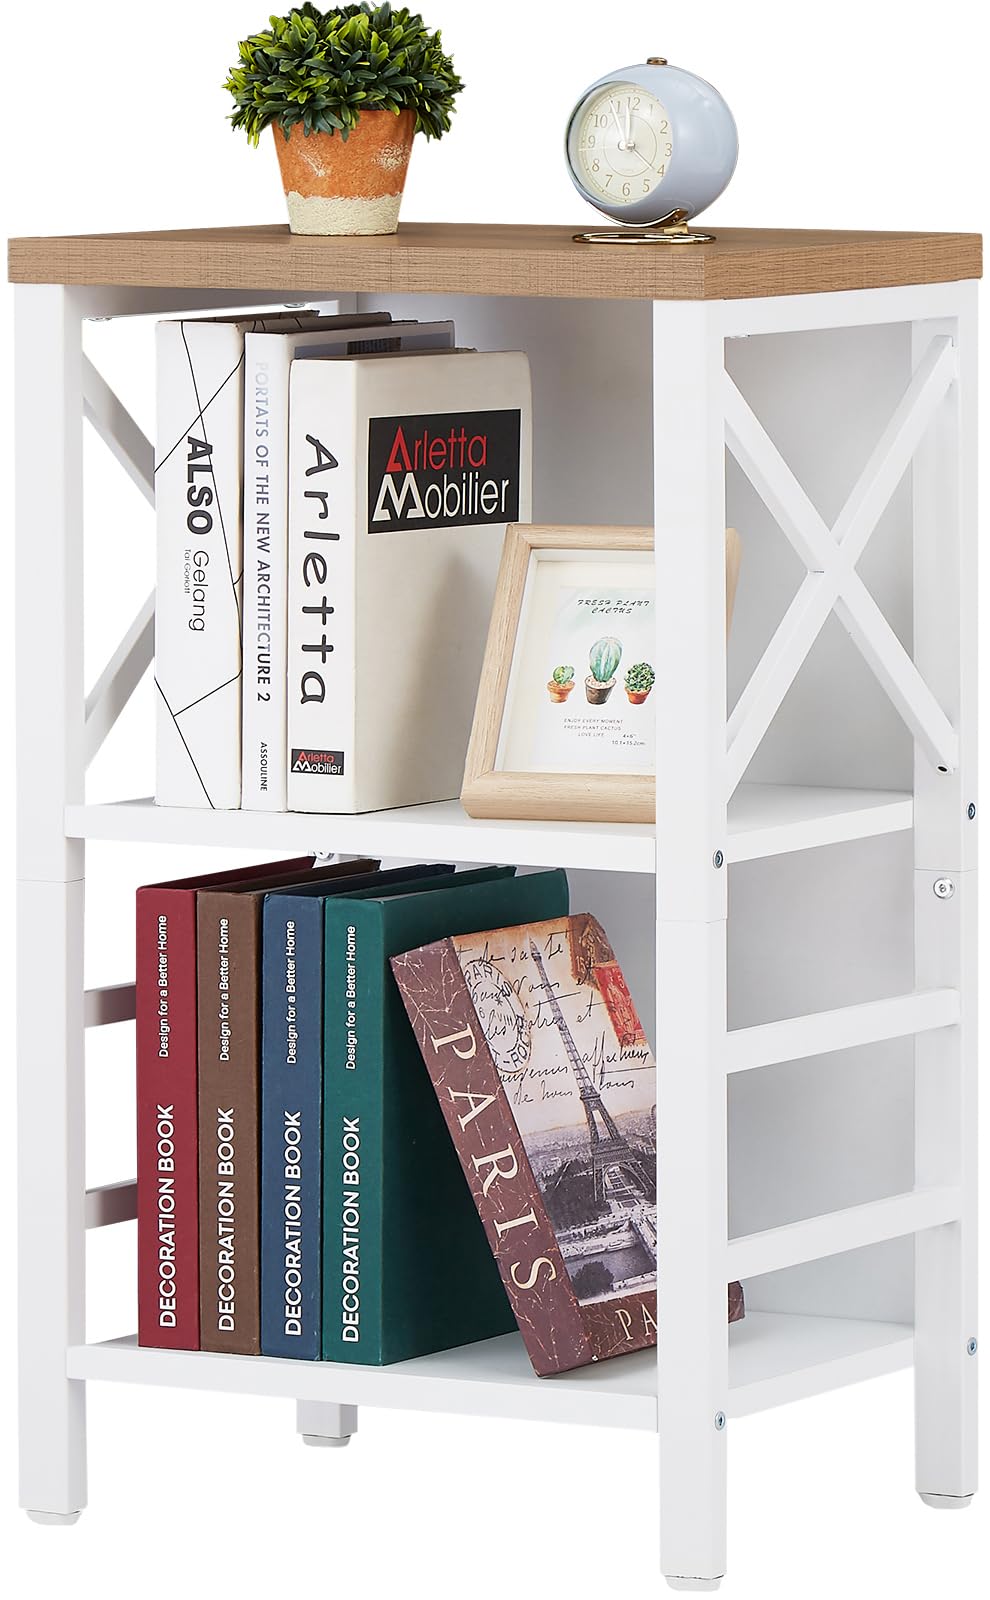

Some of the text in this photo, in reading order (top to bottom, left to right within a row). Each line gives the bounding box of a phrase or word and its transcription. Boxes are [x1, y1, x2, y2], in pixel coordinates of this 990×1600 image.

[594, 114, 608, 128] 10
[627, 97, 641, 111] 12
[648, 103, 654, 116] 1
[588, 135, 596, 149] 9
[660, 120, 668, 134] 2
[592, 158, 600, 172] 8
[665, 143, 673, 157] 3
[605, 174, 613, 187] 7
[643, 179, 651, 192] 5
[657, 164, 665, 177] 4
[622, 183, 631, 196] 6
[385, 425, 487, 473] Arletta
[372, 471, 509, 522] Mobilier
[187, 436, 214, 632] ALSO Gelang
[255, 362, 271, 702] PORTATS OF THE NEW ARCHITECTURE 2
[183, 549, 192, 560] Tai
[300, 433, 340, 705] Arletta
[259, 741, 268, 792] ASSOULINE
[292, 760, 342, 774] Mobilier
[298, 751, 334, 763] Arletta
[157, 915, 167, 950] Home
[157, 952, 167, 987] Better
[157, 998, 167, 1016] for
[219, 918, 231, 1061] Design for a Better Home
[286, 920, 298, 1064] Design for a Better Home
[345, 925, 358, 1070] Design for a Better Home
[157, 1018, 169, 1058] Design
[431, 1022, 558, 1291] PARIS
[158, 1104, 175, 1327] DECORATION BOOK
[218, 1107, 234, 1331] DECORATION BOOK
[284, 1110, 302, 1336] DECORATION BOOK
[342, 1116, 360, 1342] DECORATION BOOK
